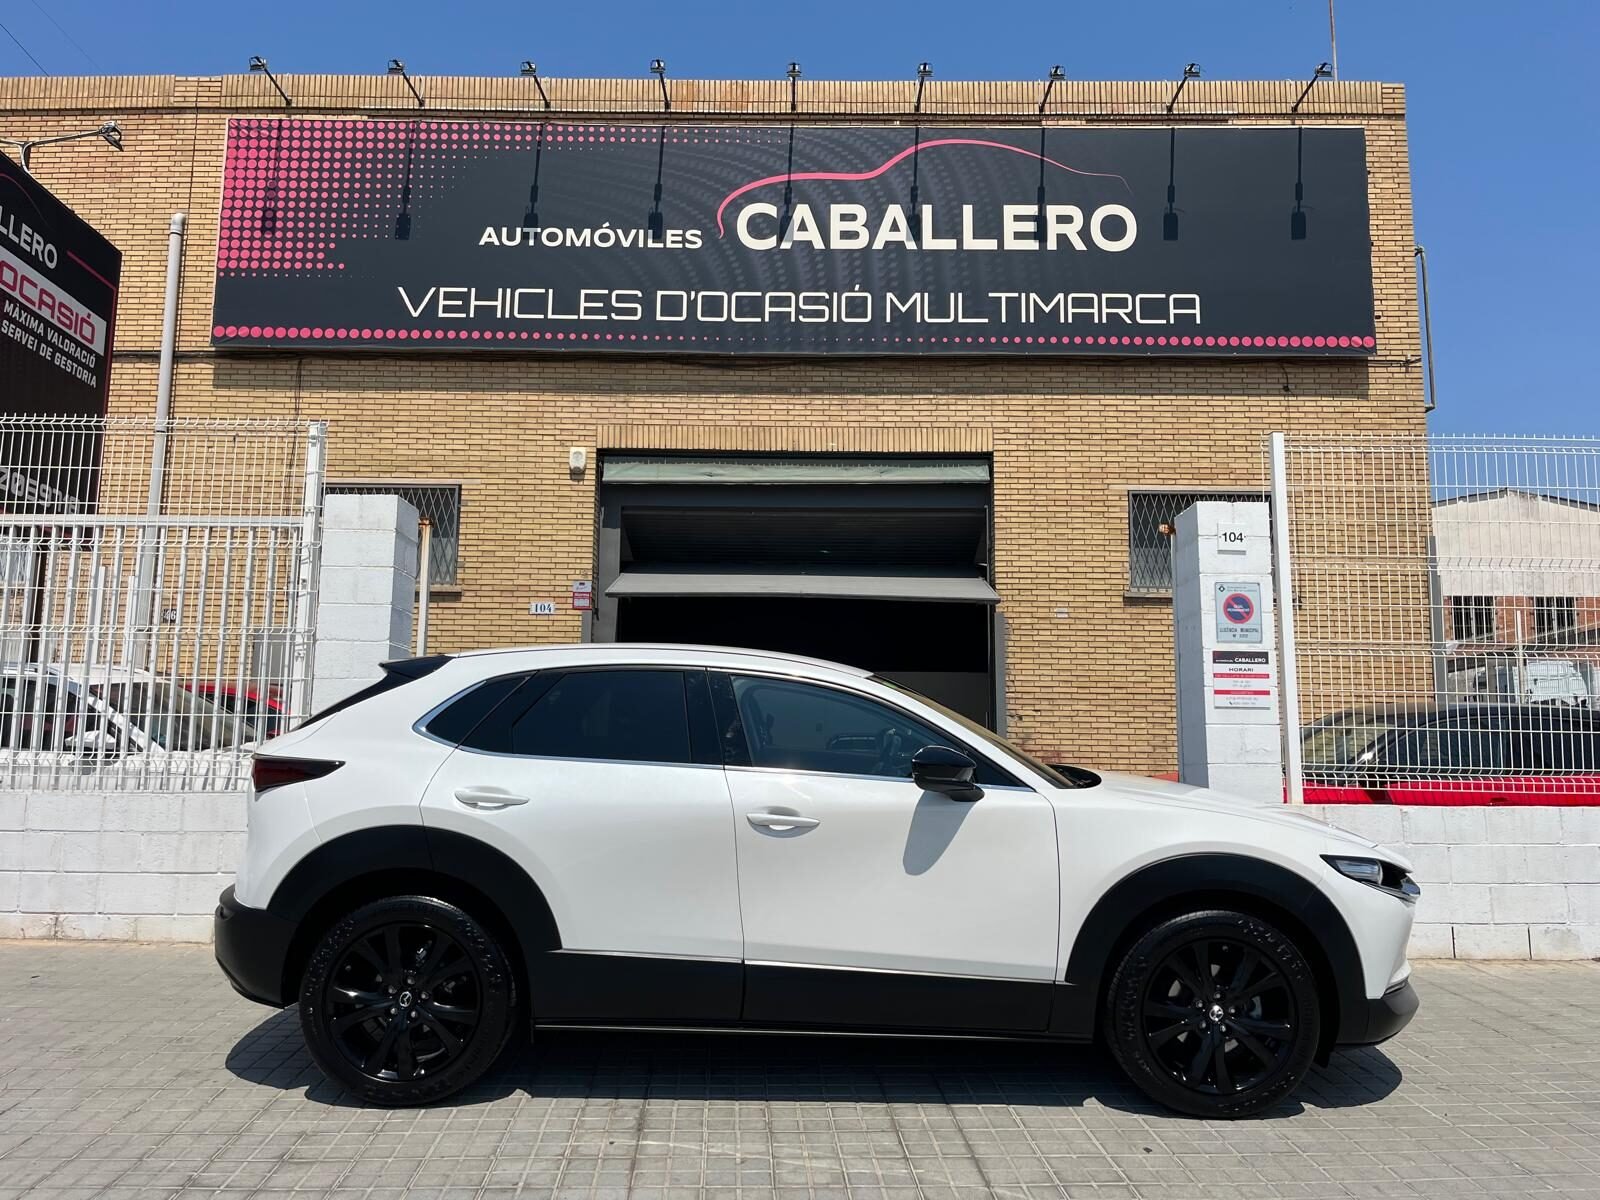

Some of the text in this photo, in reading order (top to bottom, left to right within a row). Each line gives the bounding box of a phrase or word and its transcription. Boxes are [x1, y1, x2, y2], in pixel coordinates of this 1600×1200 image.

[479, 203, 1138, 252] AUTOMÓVILES CABALLERO
[397, 285, 1201, 325] VEHICLES D'OCASIÓ MULTIMARCA
[1, 319, 97, 388] SERVEI DE GESTORIA
[3, 299, 96, 369] MÀXIMA VALORACIÓ
[1222, 531, 1244, 543] 104
[534, 603, 552, 613] 104
